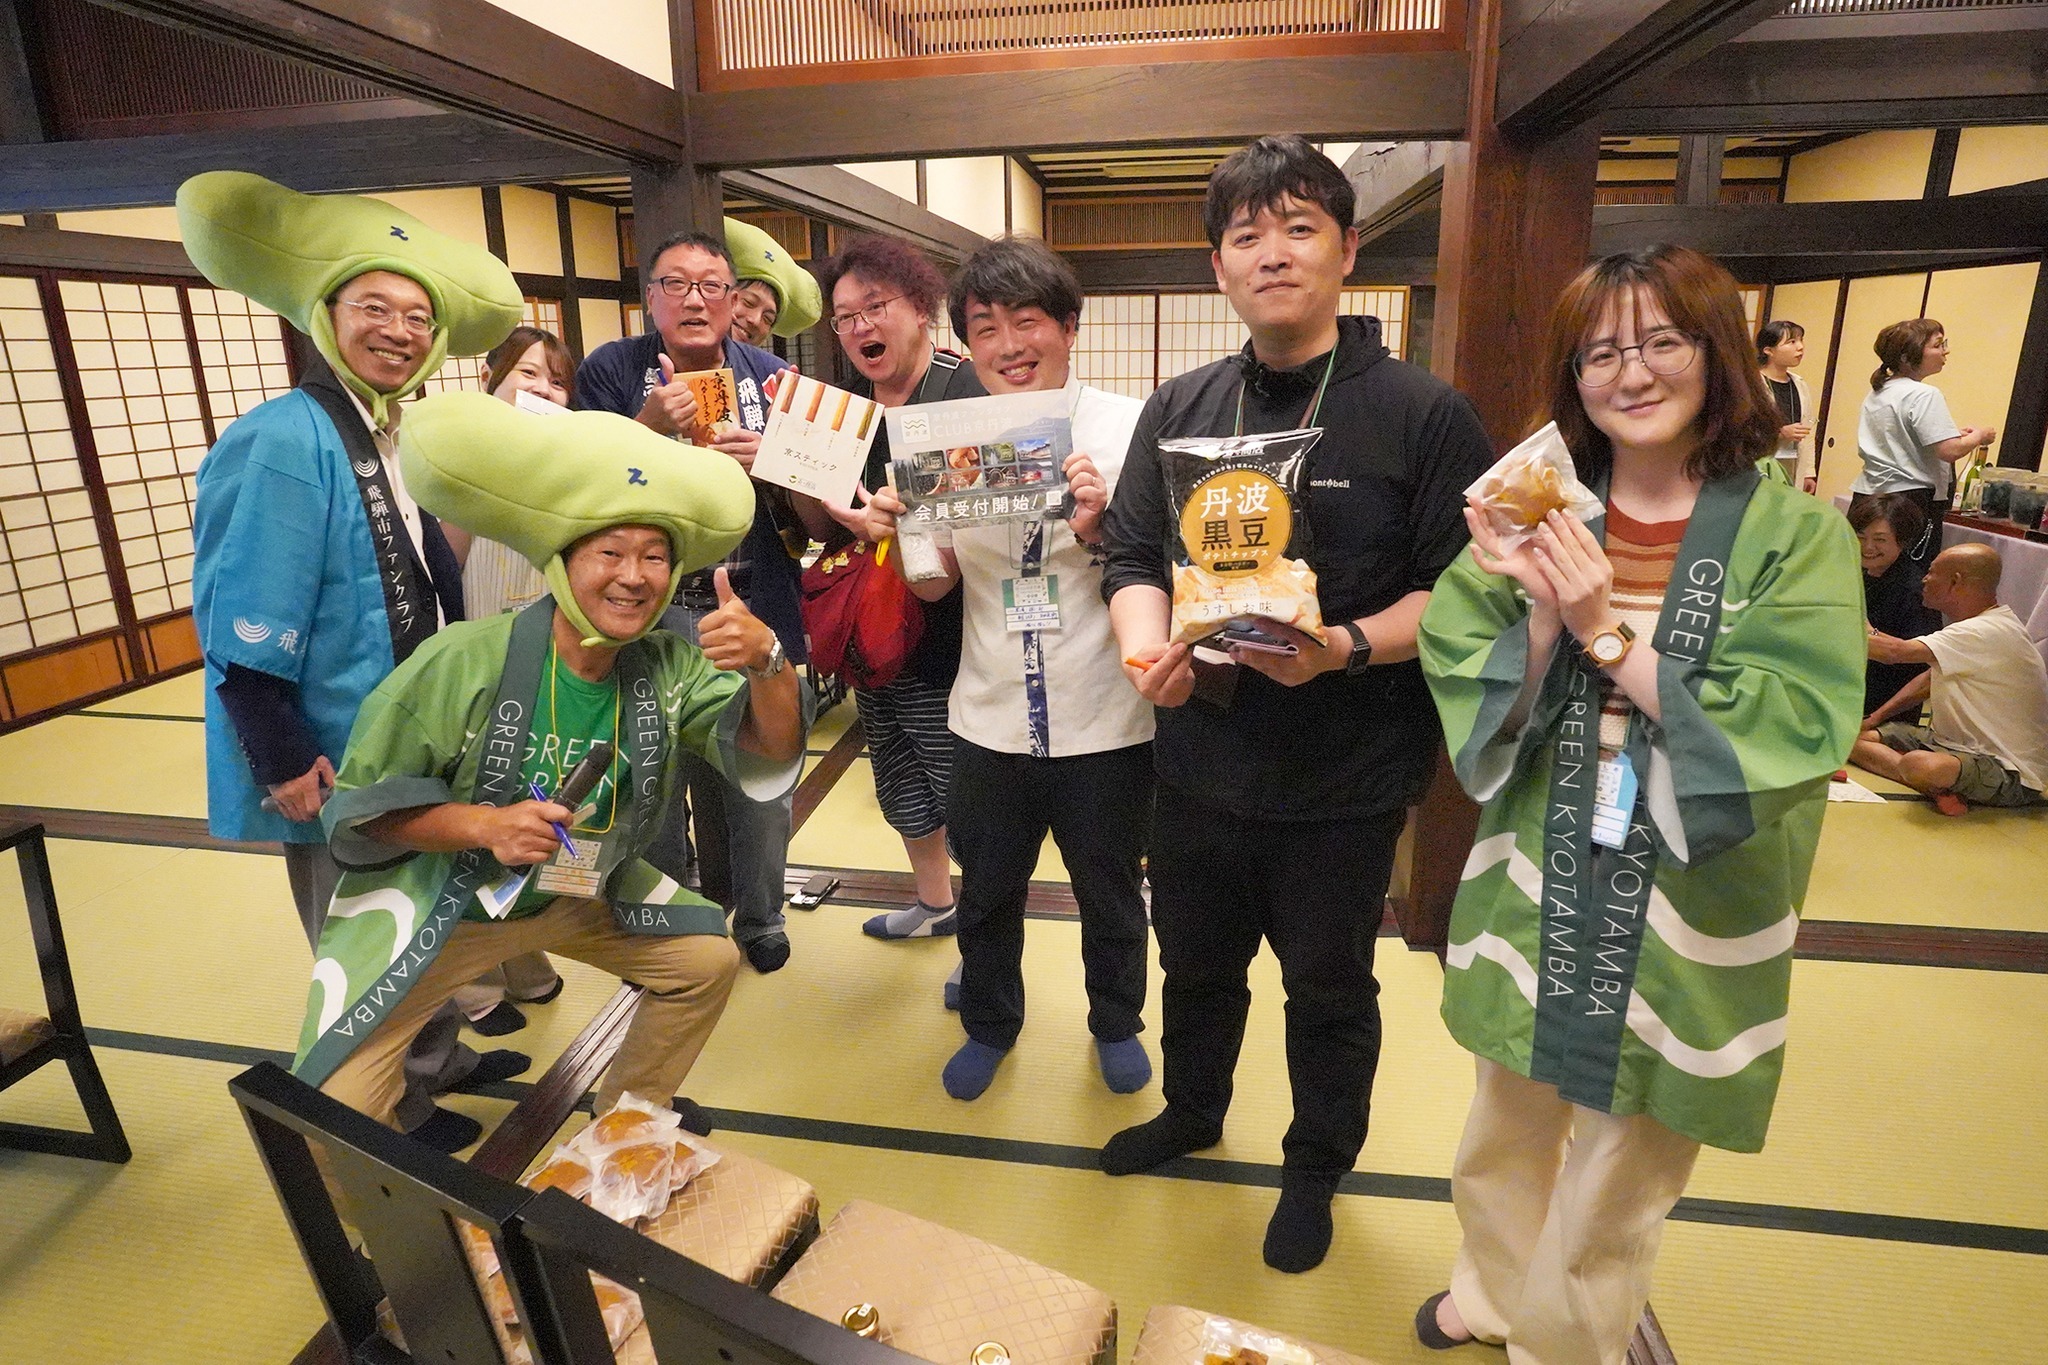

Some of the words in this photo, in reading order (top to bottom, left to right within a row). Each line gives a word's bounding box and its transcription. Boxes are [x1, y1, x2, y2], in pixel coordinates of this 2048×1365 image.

[709, 371, 733, 424] 京丹波
[783, 446, 838, 472] 京スティック
[1200, 481, 1271, 519] 丹波
[1201, 516, 1271, 551] 黒豆
[366, 484, 415, 634] 飛騨市ファンクラブ
[1202, 548, 1270, 562] ポテトチップス
[1202, 601, 1273, 618] うすしお味
[482, 699, 523, 793] GREEN
[633, 678, 661, 767] GREEN
[1546, 803, 1578, 996] KYOTAMBA
[1585, 822, 1652, 1016] KYOTAMBA
[333, 892, 461, 1037] KYOTAMBA
